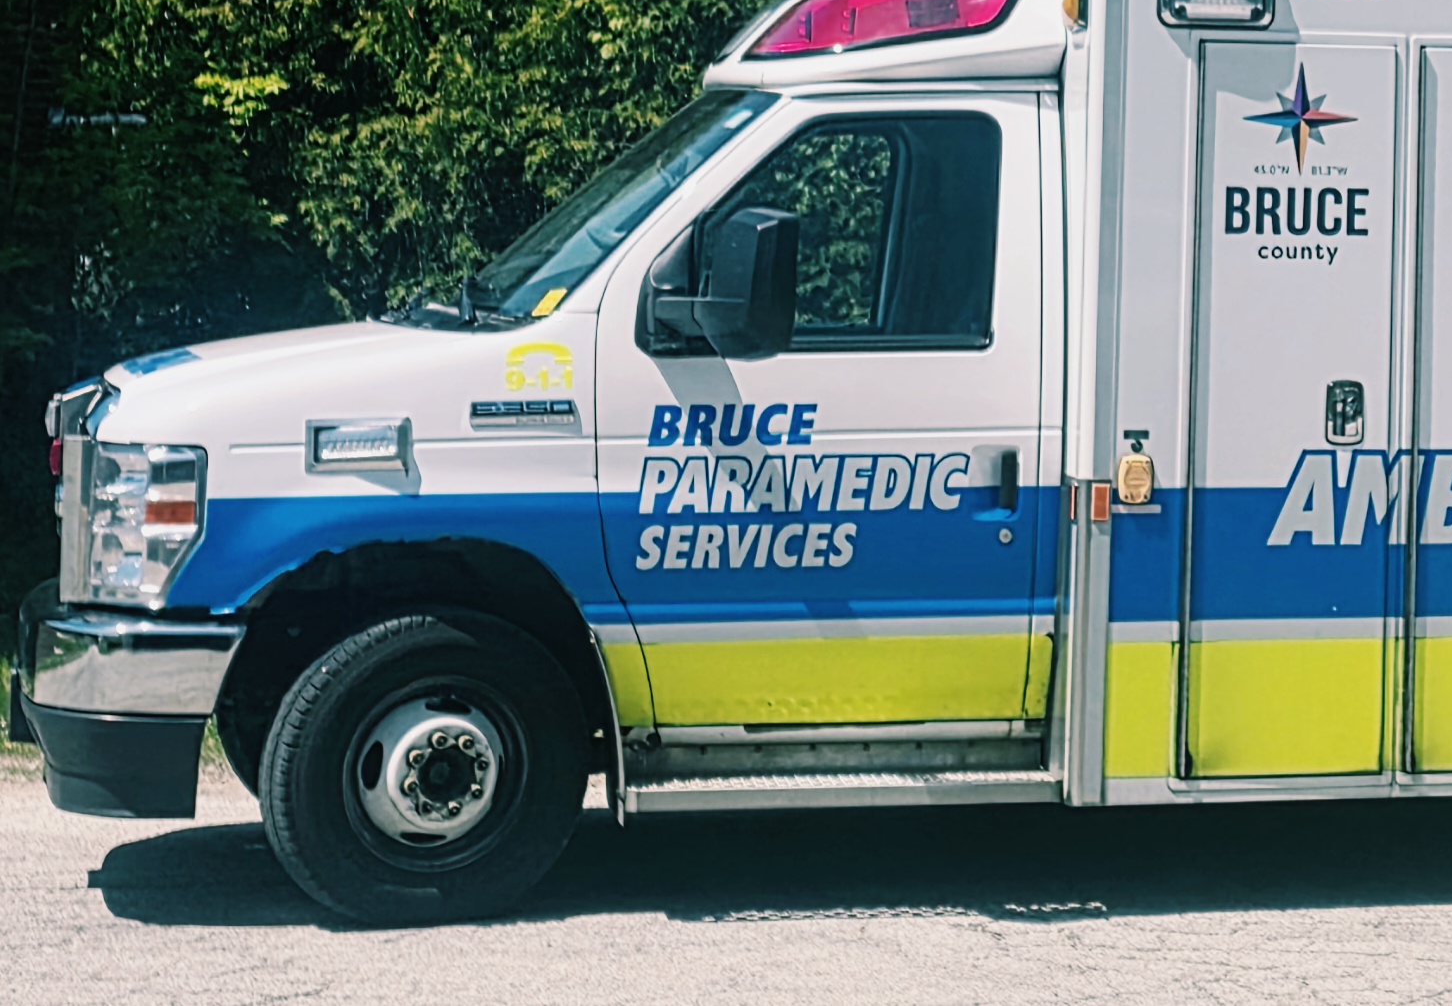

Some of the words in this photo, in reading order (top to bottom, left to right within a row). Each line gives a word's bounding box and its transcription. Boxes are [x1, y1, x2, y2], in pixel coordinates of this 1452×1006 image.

[1225, 186, 1370, 237] BRUCE
[1258, 244, 1339, 266] county
[505, 365, 573, 392] 9-1-1
[648, 402, 818, 447] BRUCE
[638, 452, 970, 515] PARAMEDIC
[635, 522, 857, 571] SERVICES
